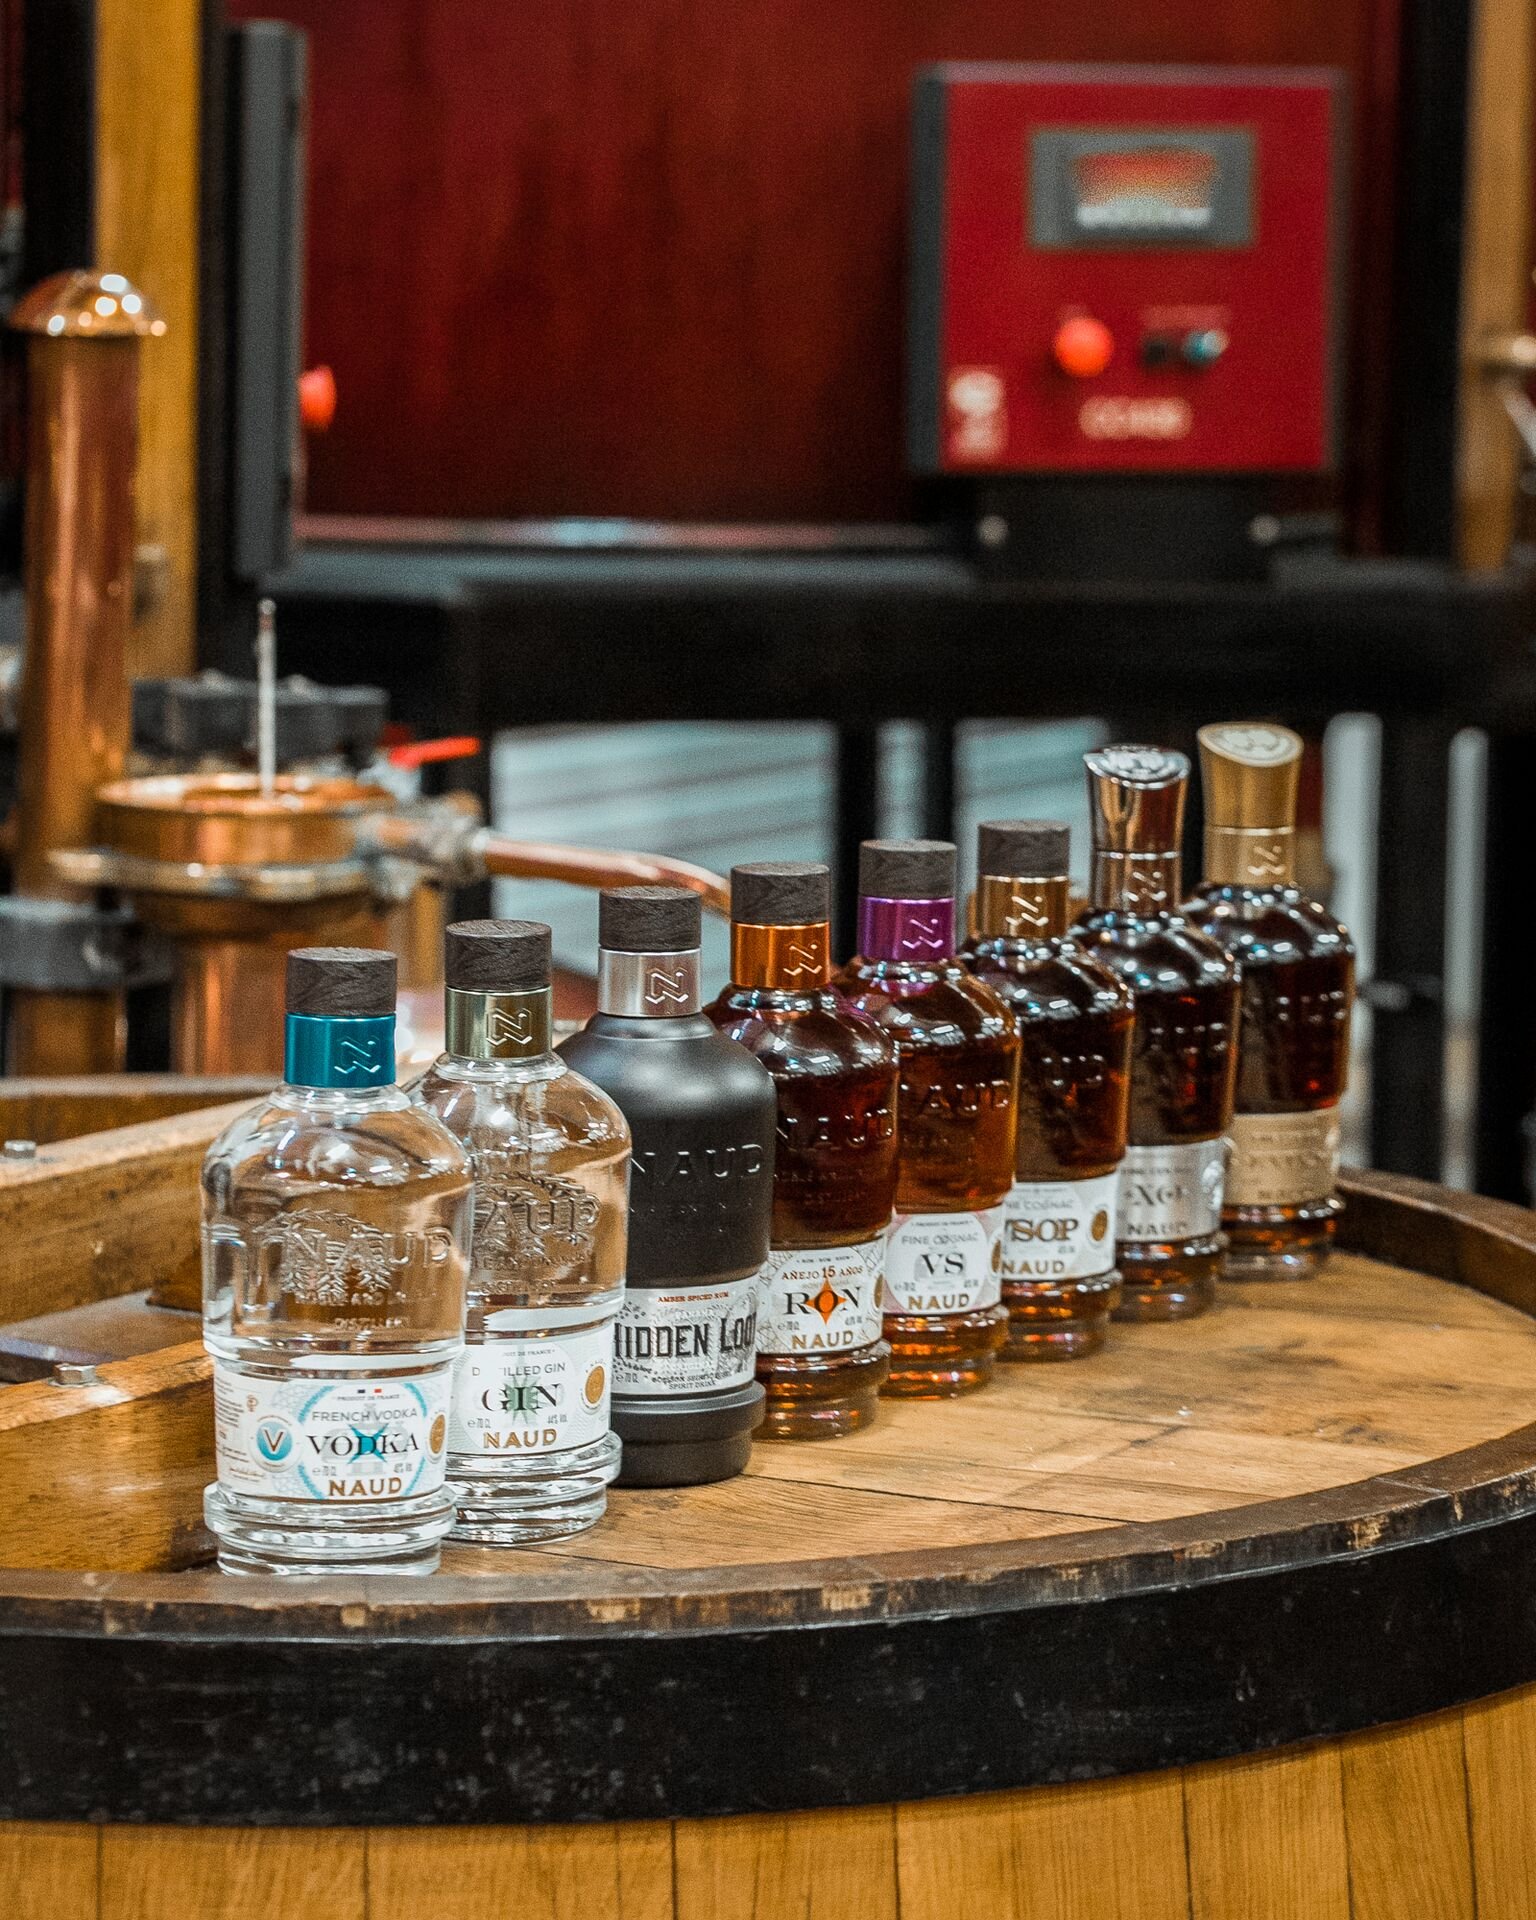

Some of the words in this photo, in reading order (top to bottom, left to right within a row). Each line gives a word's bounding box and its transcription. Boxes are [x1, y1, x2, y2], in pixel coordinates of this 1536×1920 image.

[901, 1235, 930, 1246] FINE
[822, 1265, 836, 1279] 15
[921, 1252, 964, 1275] VS
[1001, 1260, 1065, 1275] NAUD
[783, 1286, 862, 1316] RON
[908, 1293, 969, 1310] NAUD
[791, 1330, 854, 1350] NAUD
[544, 1363, 566, 1374] GIN
[481, 1382, 561, 1412] GIN
[312, 1411, 370, 1422] FRENCH
[374, 1408, 418, 1421] VODKA
[264, 1427, 284, 1452] V
[306, 1432, 420, 1457] VODKA
[483, 1428, 557, 1449] NAUD
[328, 1477, 402, 1497] NAUD
